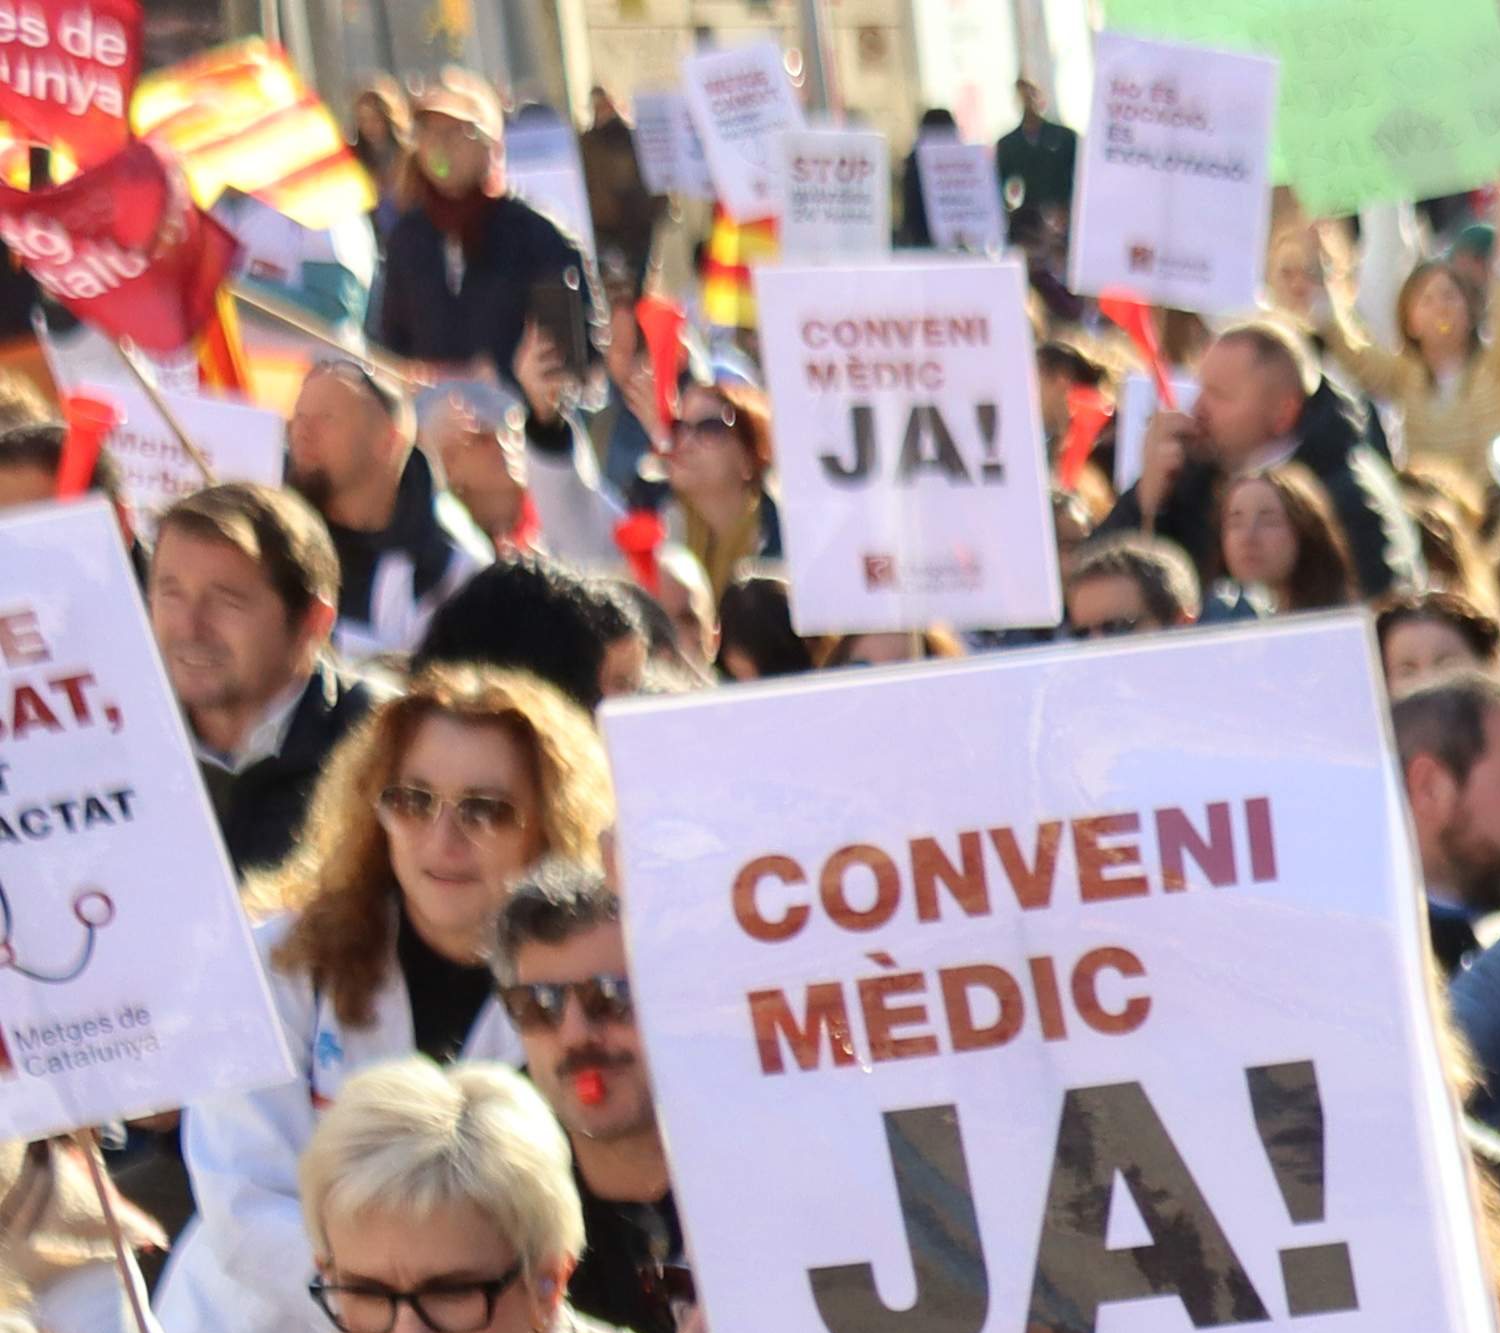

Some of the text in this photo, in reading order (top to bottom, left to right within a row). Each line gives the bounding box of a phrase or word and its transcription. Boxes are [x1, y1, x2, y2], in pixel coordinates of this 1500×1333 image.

[800, 316, 991, 349] CONVENI
[805, 356, 946, 393] MÈDIC
[818, 402, 1007, 492] JA!
[730, 796, 1278, 943] CONVENI
[13, 1006, 152, 1053] Metges de
[746, 945, 1154, 1076] MÈDIC
[25, 1033, 161, 1078] Catalunya
